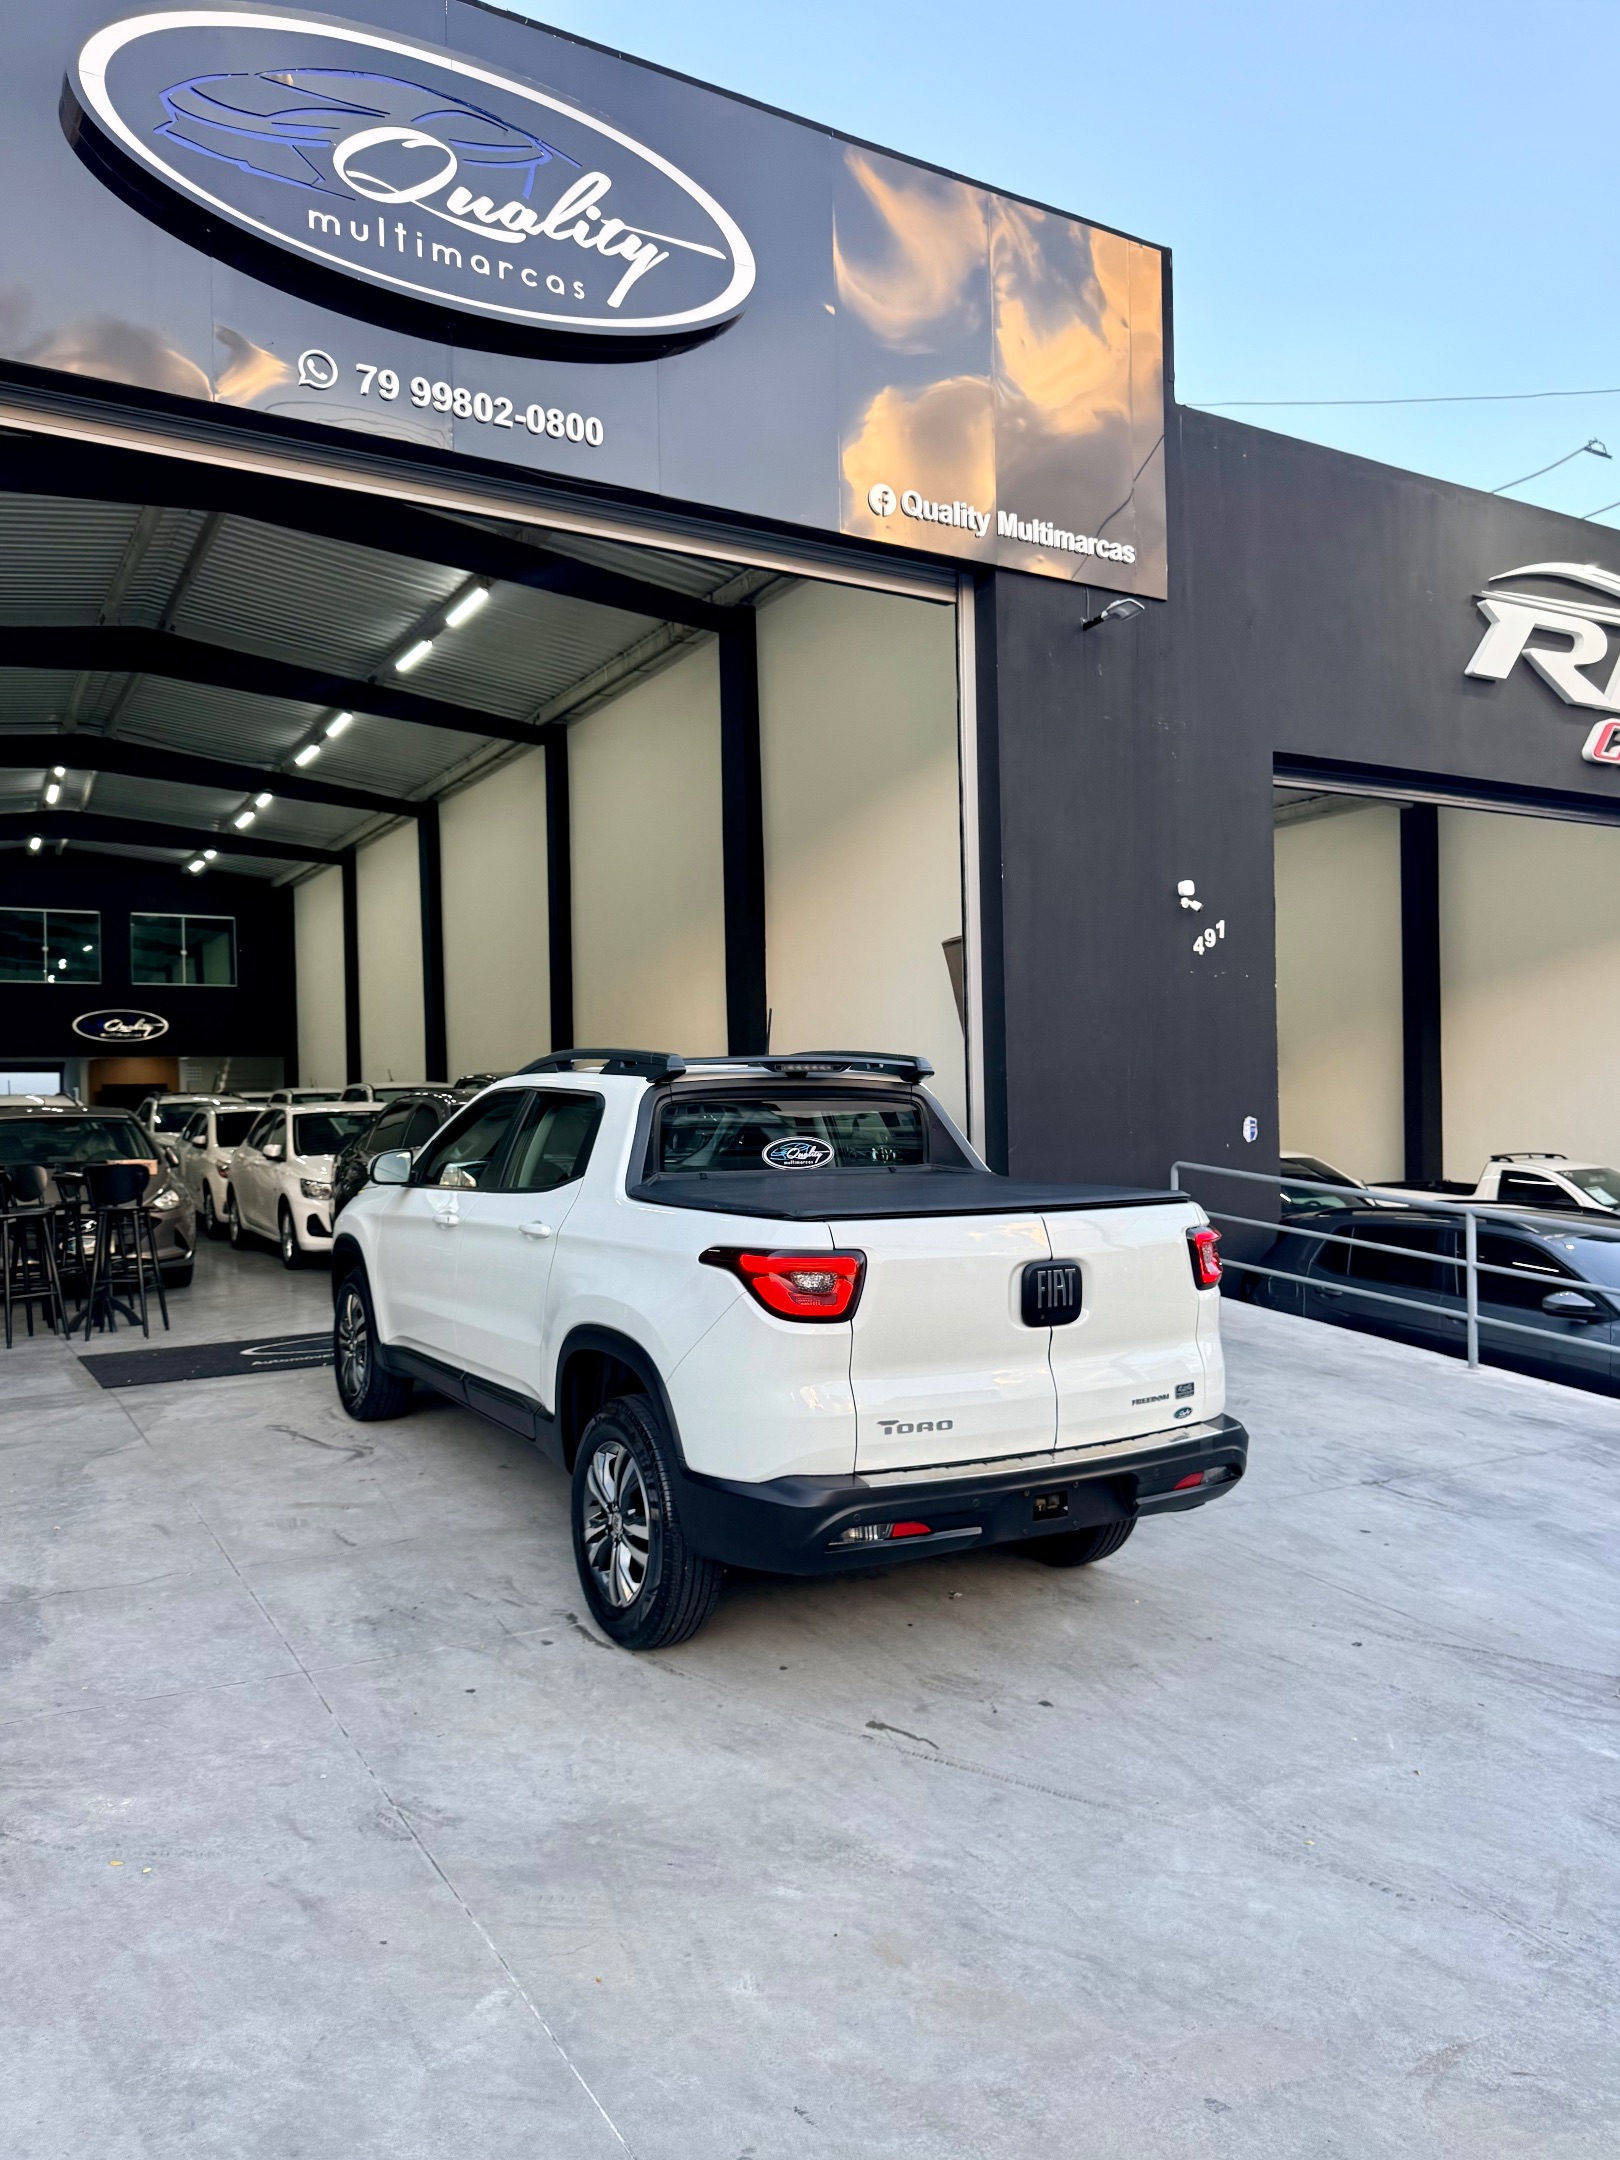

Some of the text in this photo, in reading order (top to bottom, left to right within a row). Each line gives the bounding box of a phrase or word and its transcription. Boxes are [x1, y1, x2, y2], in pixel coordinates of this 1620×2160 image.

[307, 208, 586, 300] multimarcas
[333, 126, 726, 308] Quality
[355, 362, 604, 447] 79 99802-0800
[900, 489, 1136, 564] Quality Multimarcas
[1192, 919, 1225, 955] 491
[1037, 1268, 1076, 1309] FIAT
[876, 1419, 953, 1435] TORO
